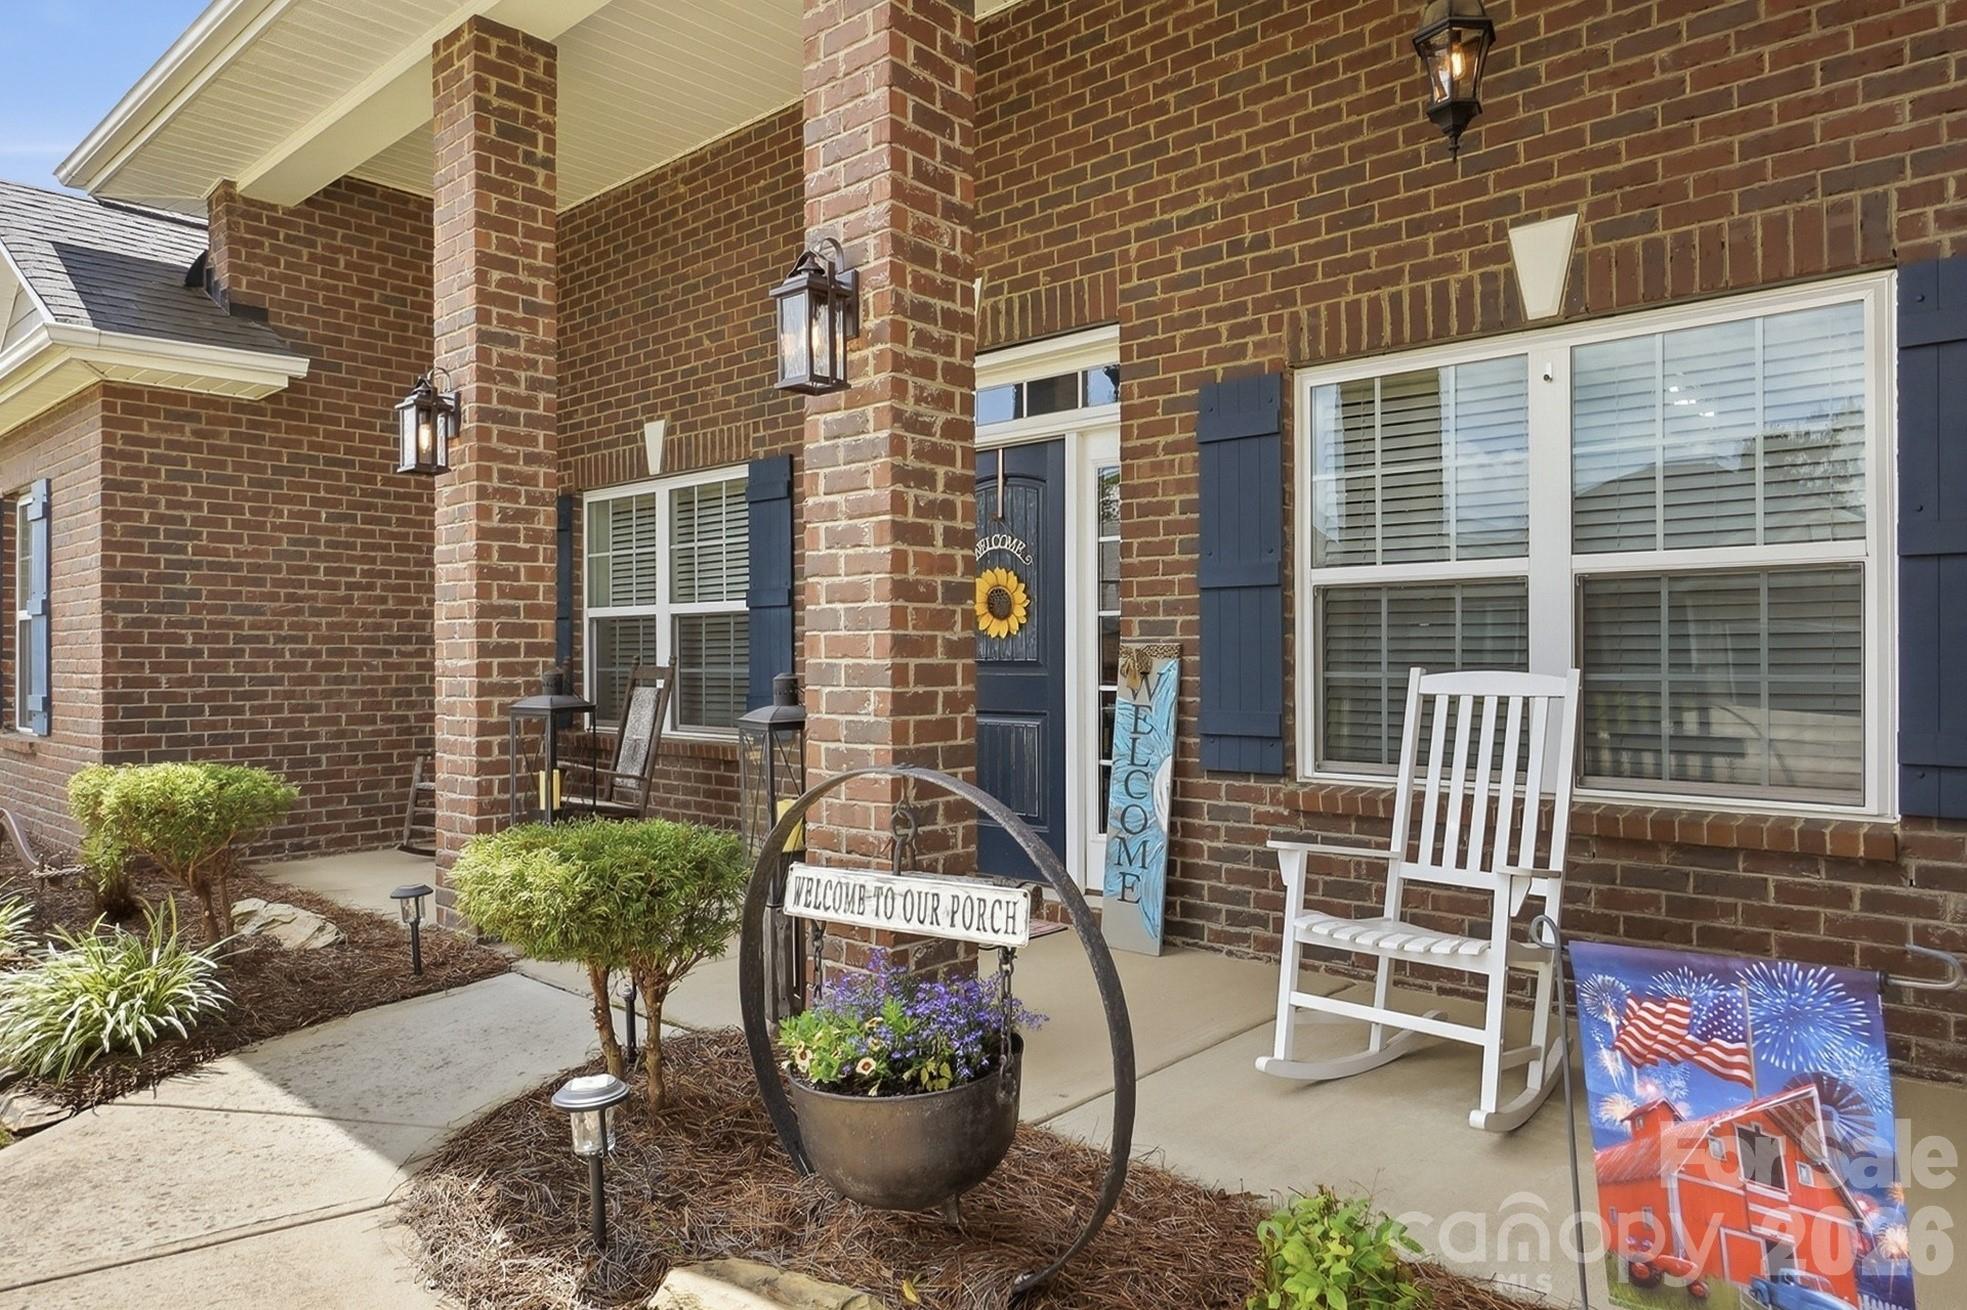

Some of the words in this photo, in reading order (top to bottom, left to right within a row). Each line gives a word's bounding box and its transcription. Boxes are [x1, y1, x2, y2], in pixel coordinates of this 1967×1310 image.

[1114, 671, 1165, 904] WELCOME
[792, 875, 866, 916] WELCOME
[872, 887, 895, 920] TO
[902, 889, 941, 927] OUR
[949, 894, 1018, 936] PORCH
